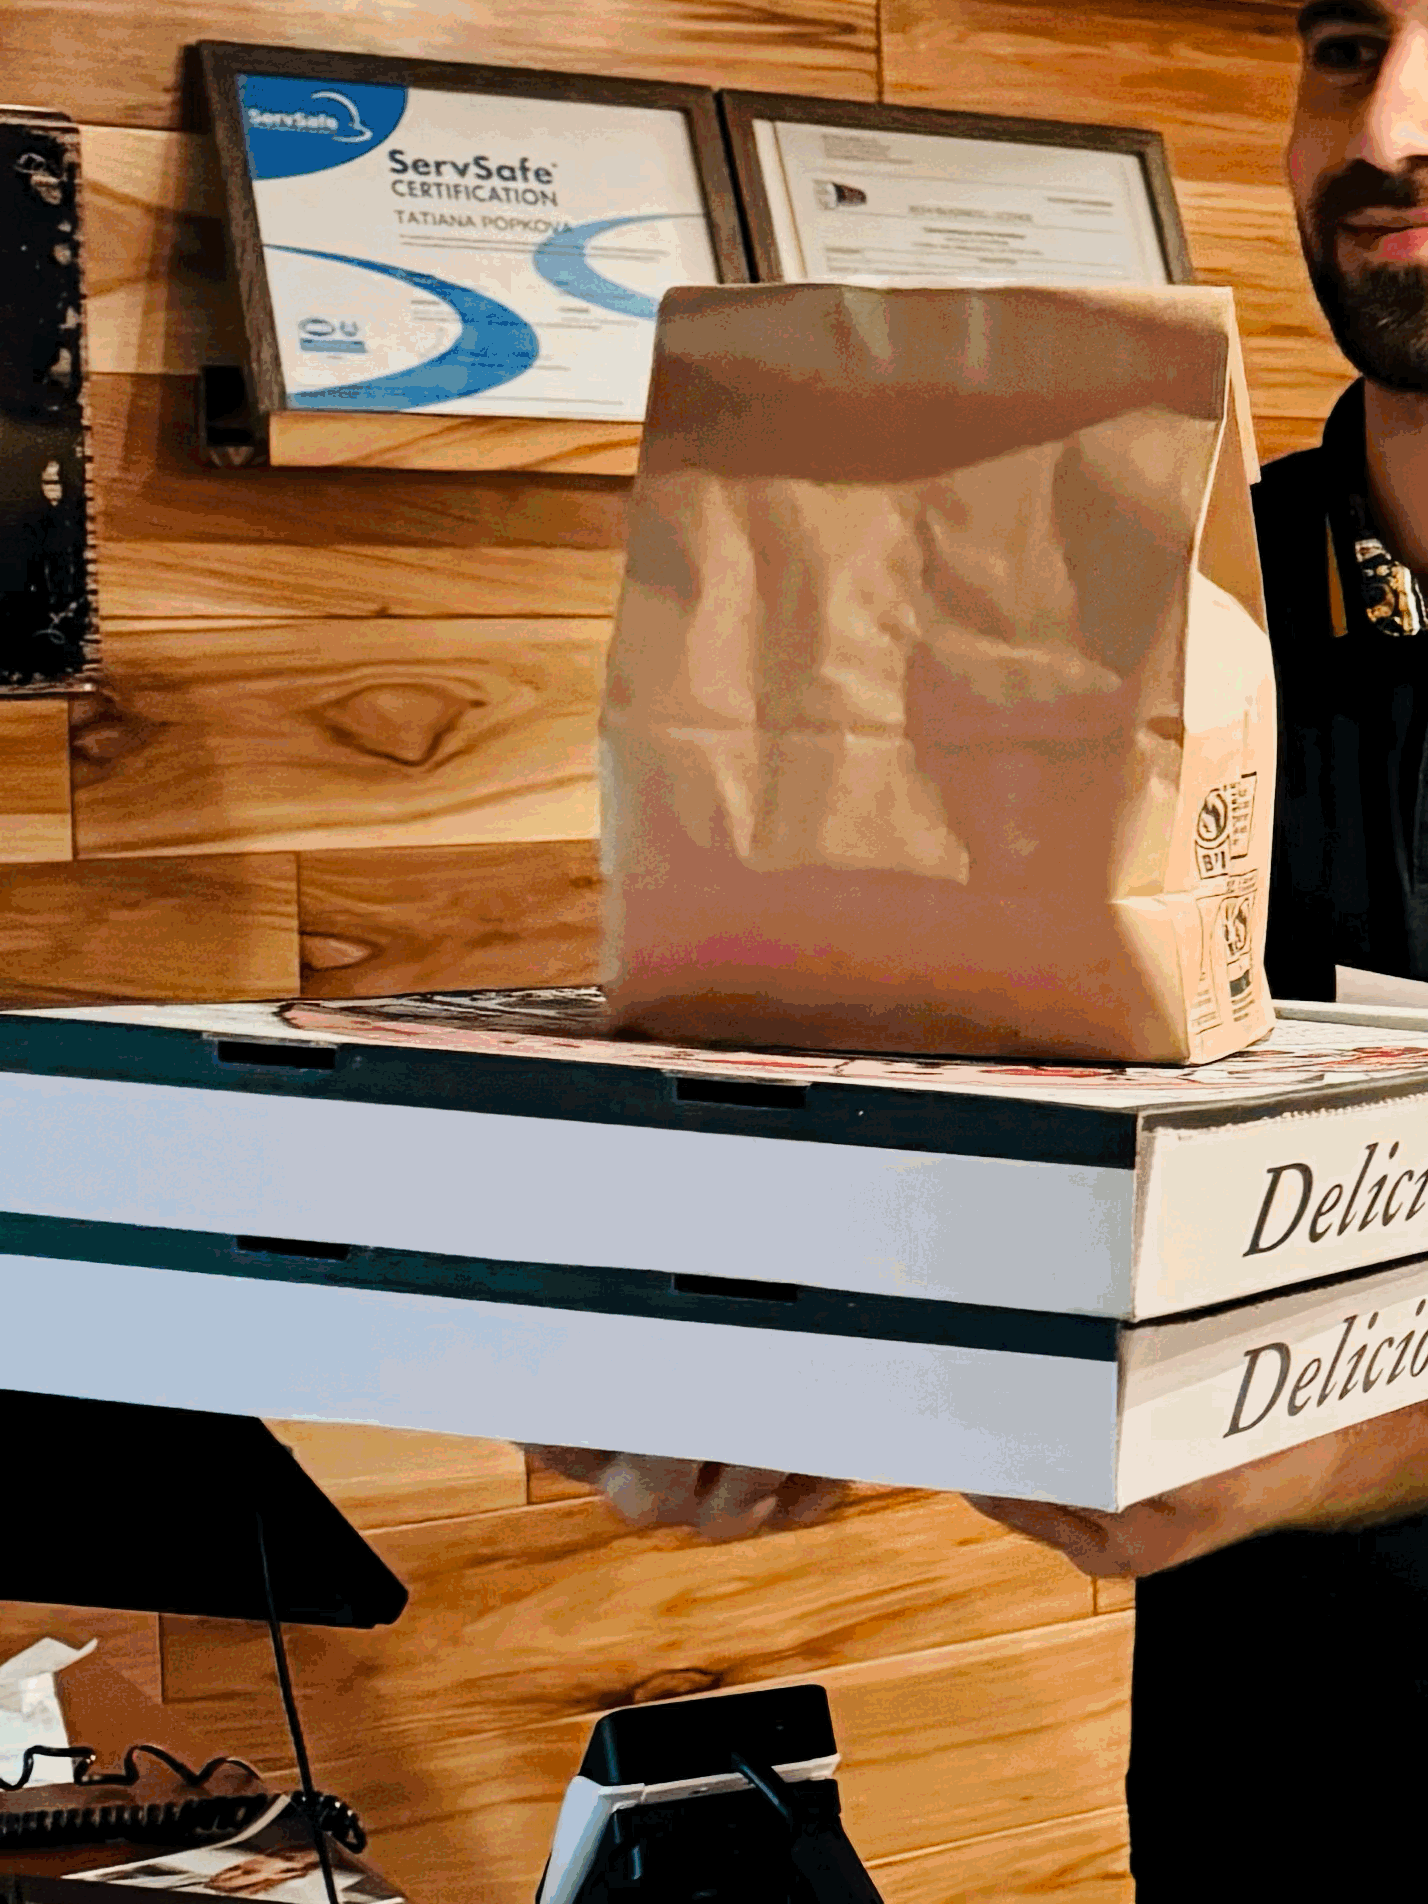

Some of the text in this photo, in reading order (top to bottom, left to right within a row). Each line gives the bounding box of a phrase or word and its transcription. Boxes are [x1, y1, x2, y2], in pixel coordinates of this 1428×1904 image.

[248, 108, 339, 133] ServSafe
[389, 149, 554, 184] ServSafe
[391, 180, 559, 207] CERTIFICATION
[395, 210, 574, 234] TATIANA POPKOVA
